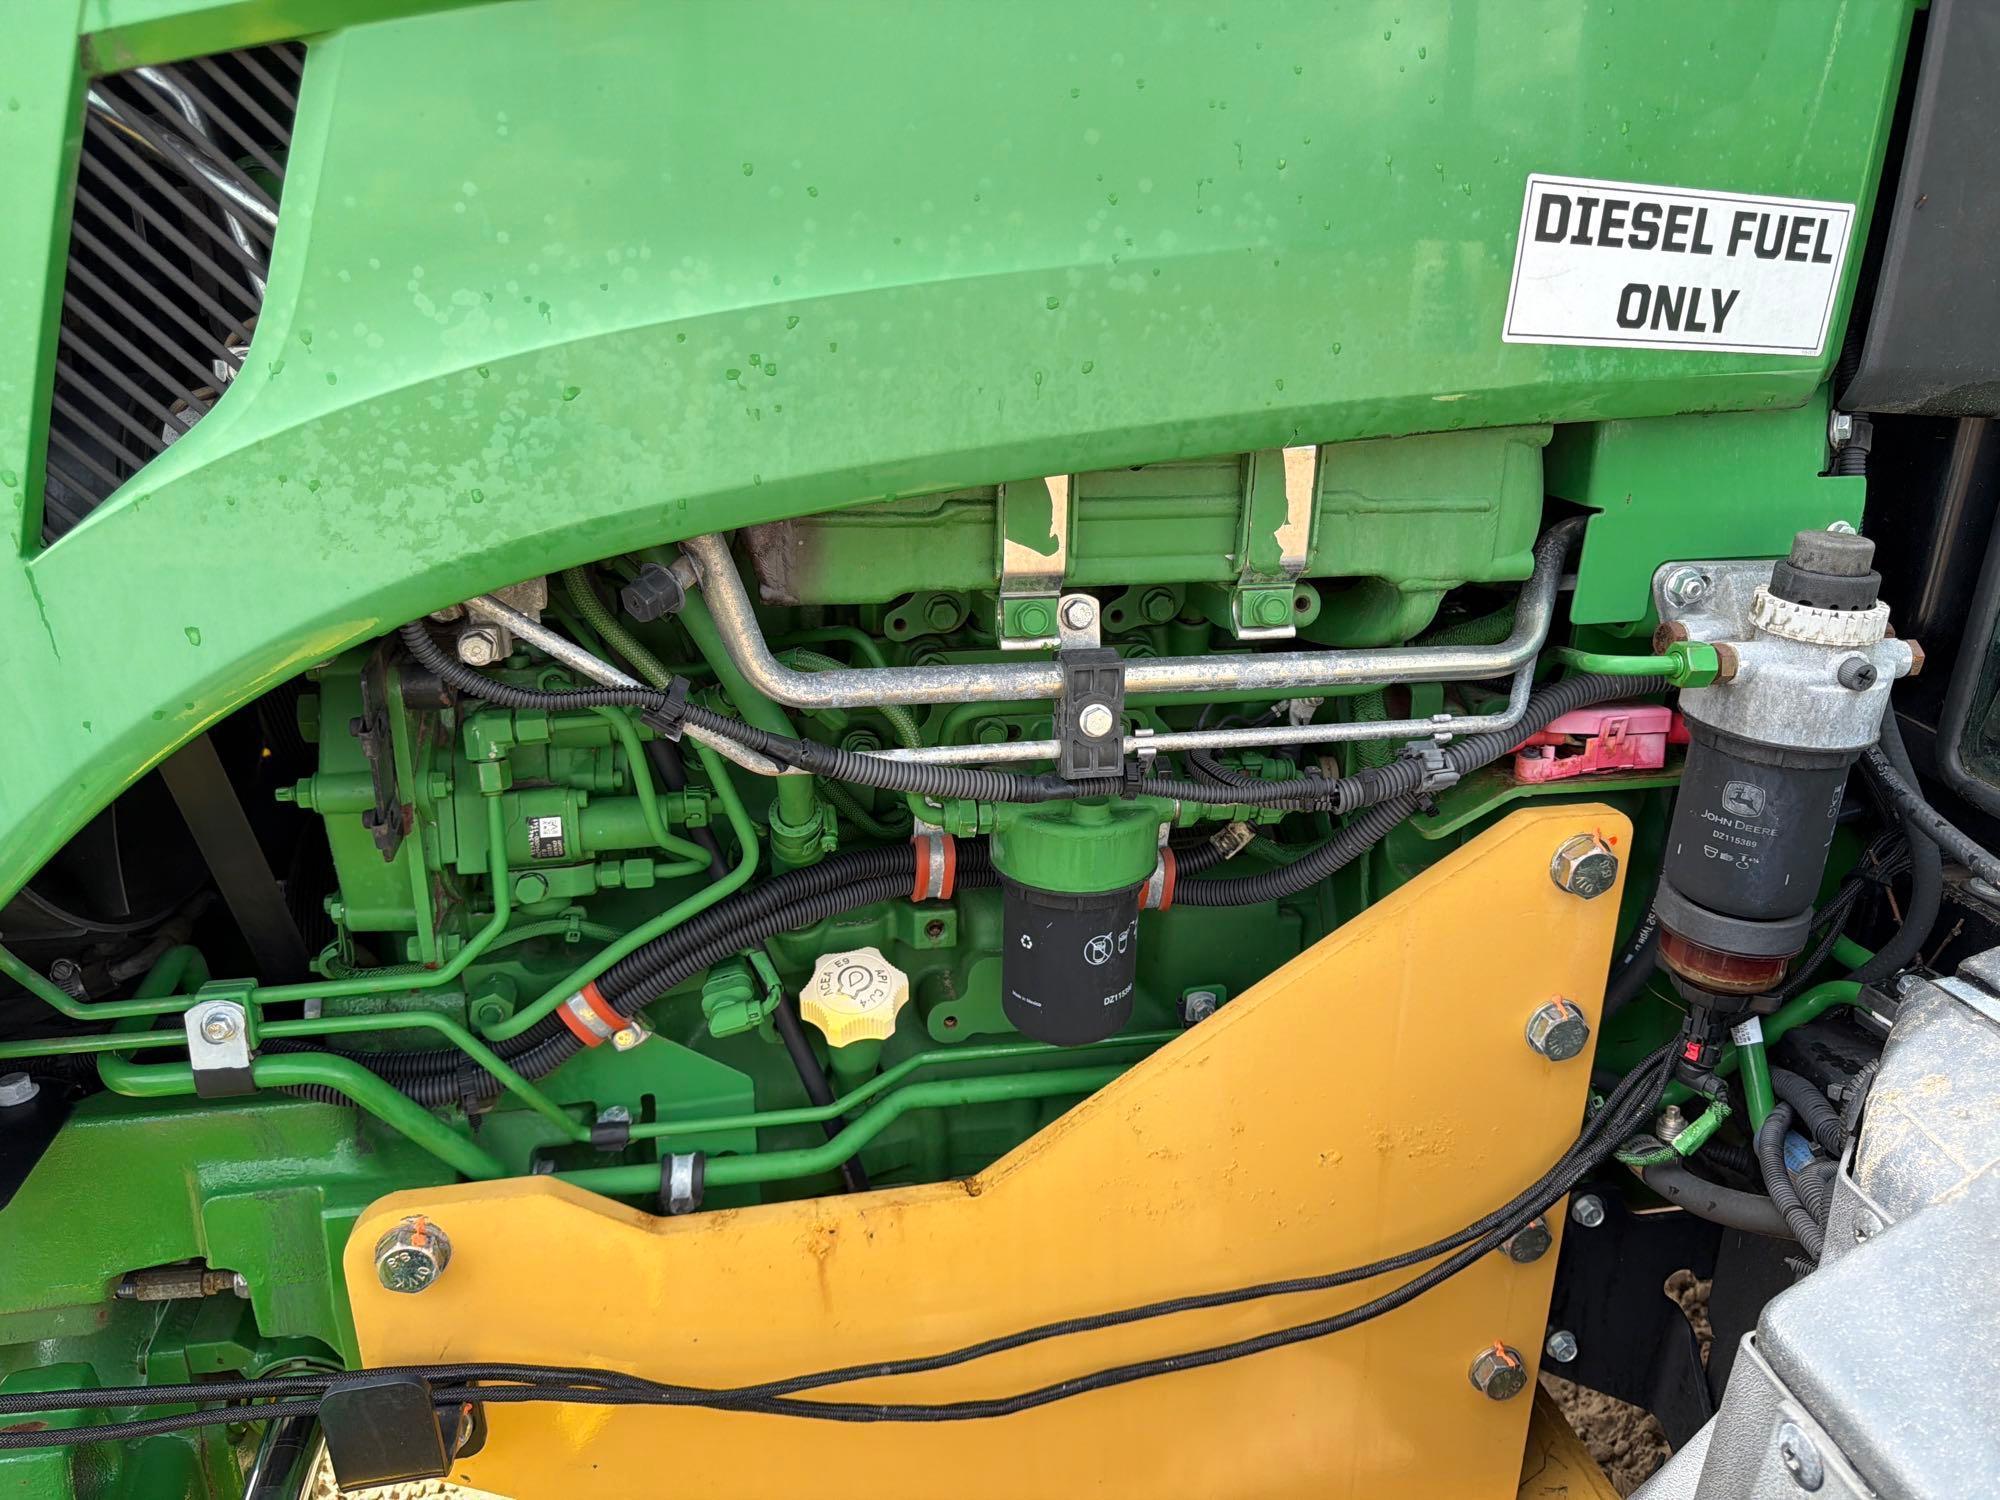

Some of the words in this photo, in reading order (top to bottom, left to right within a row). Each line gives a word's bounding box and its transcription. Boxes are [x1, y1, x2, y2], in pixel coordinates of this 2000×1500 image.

[1534, 193, 1713, 255] DIESEL
[1726, 211, 1833, 264] FUEL
[1616, 282, 1741, 334] ONLY
[1700, 809, 1732, 827] JOHN
[1734, 820, 1778, 837] DEERE
[1712, 829, 1758, 848] DZ115389
[820, 970, 834, 997] ACEA
[834, 957, 851, 969] E9
